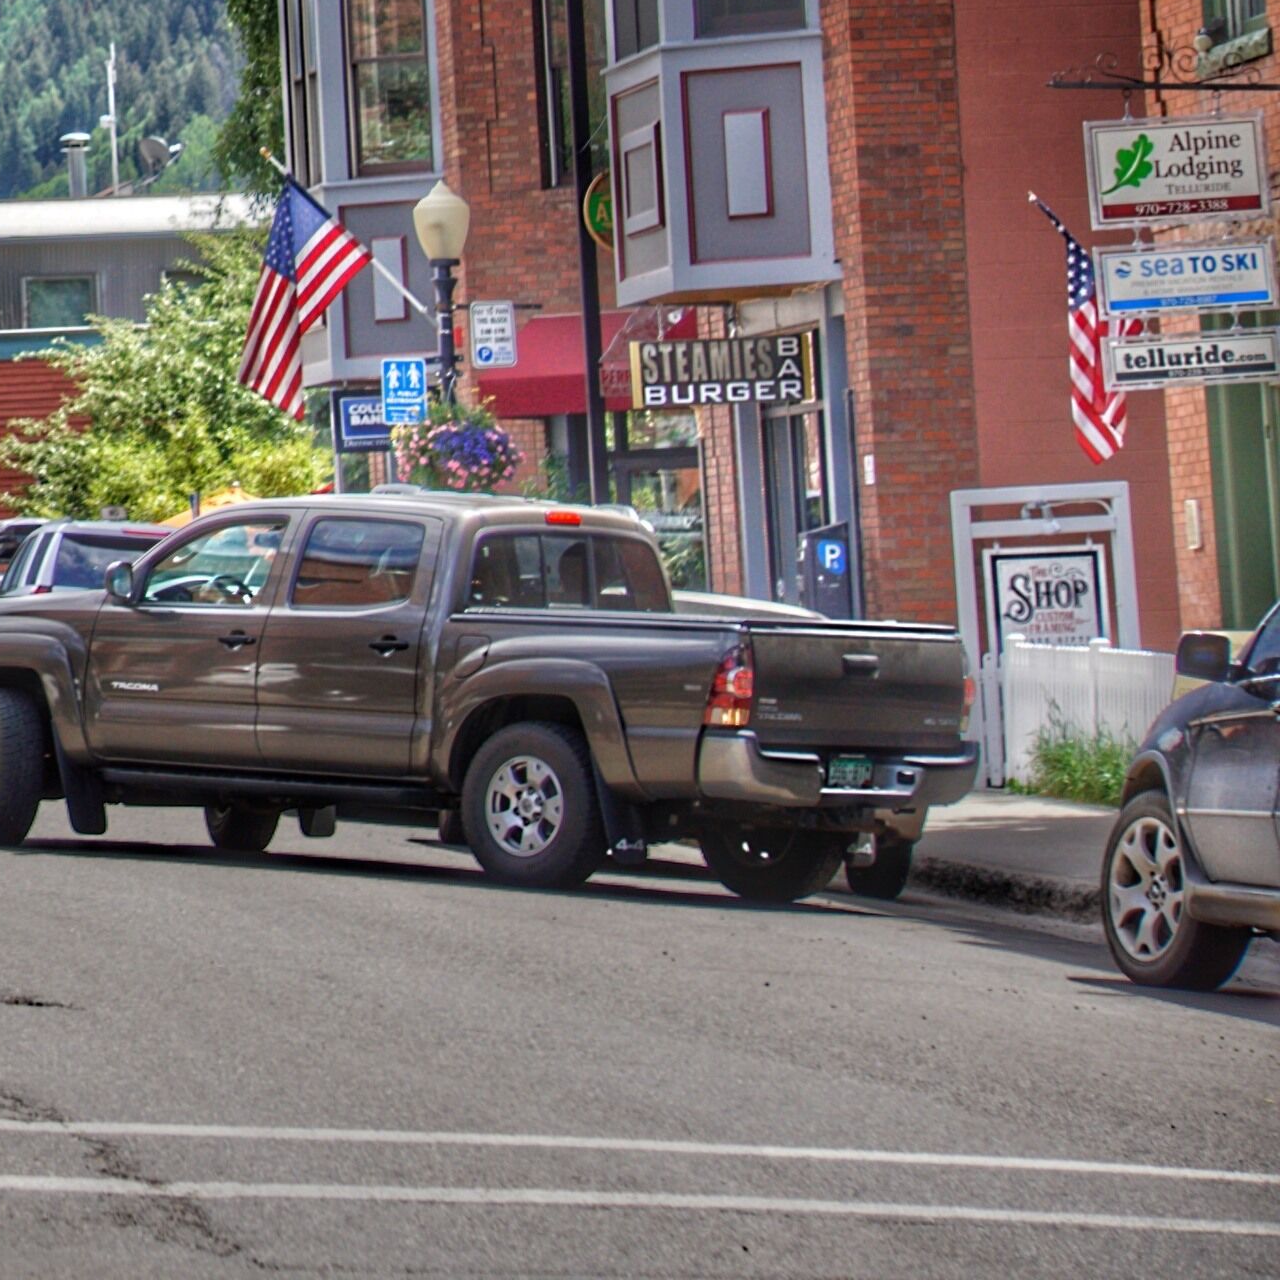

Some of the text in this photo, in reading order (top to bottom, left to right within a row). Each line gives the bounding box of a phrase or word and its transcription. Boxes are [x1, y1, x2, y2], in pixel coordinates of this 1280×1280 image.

[1169, 129, 1241, 155] Alpine
[1153, 156, 1244, 181] Lodging
[1164, 182, 1232, 196] TELLURIDE
[1134, 199, 1229, 216] 970-728-3388
[1140, 252, 1258, 278] sea TO SKI
[642, 338, 774, 385] STEAMIES
[1123, 344, 1268, 370] telluride.com
[644, 378, 802, 406] BURGER
[109, 681, 159, 693] TACOMA
